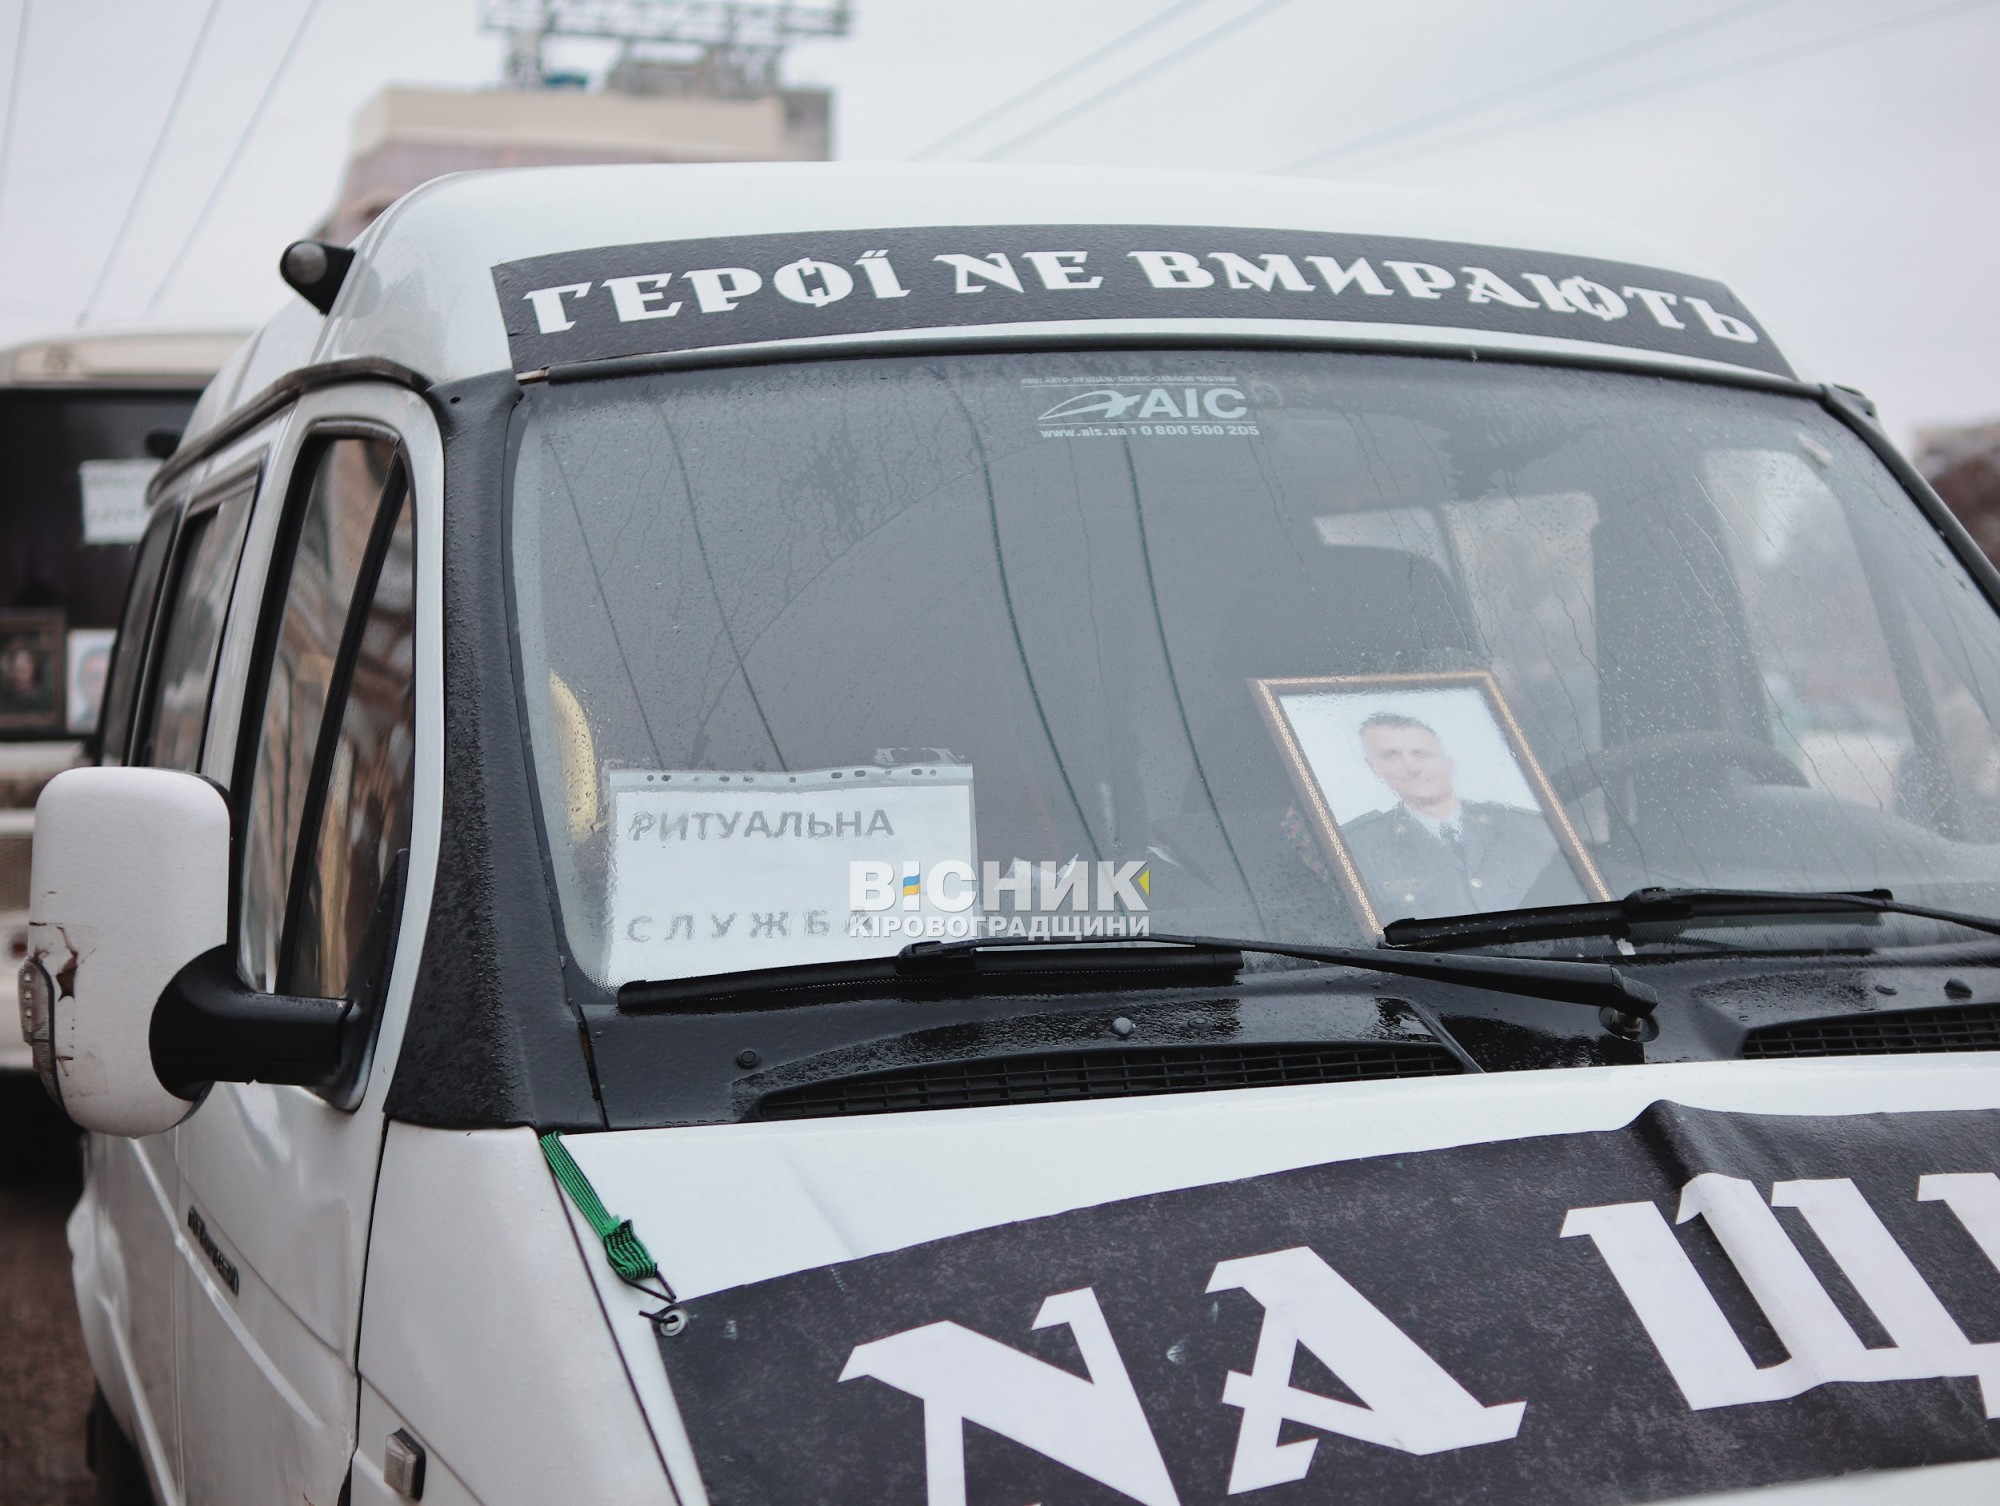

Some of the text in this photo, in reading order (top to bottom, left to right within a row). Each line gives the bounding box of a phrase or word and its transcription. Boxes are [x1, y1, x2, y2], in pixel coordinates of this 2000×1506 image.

[523, 249, 911, 335] ГЕРОЇ
[1127, 251, 1758, 344] ВМИРАЮТЬ
[1041, 426, 1127, 438] www.ais.ua
[1156, 425, 1188, 436] 800
[1191, 425, 1224, 436] 500
[1227, 425, 1260, 436] 205
[628, 808, 895, 842] РИТУАЛЬНА
